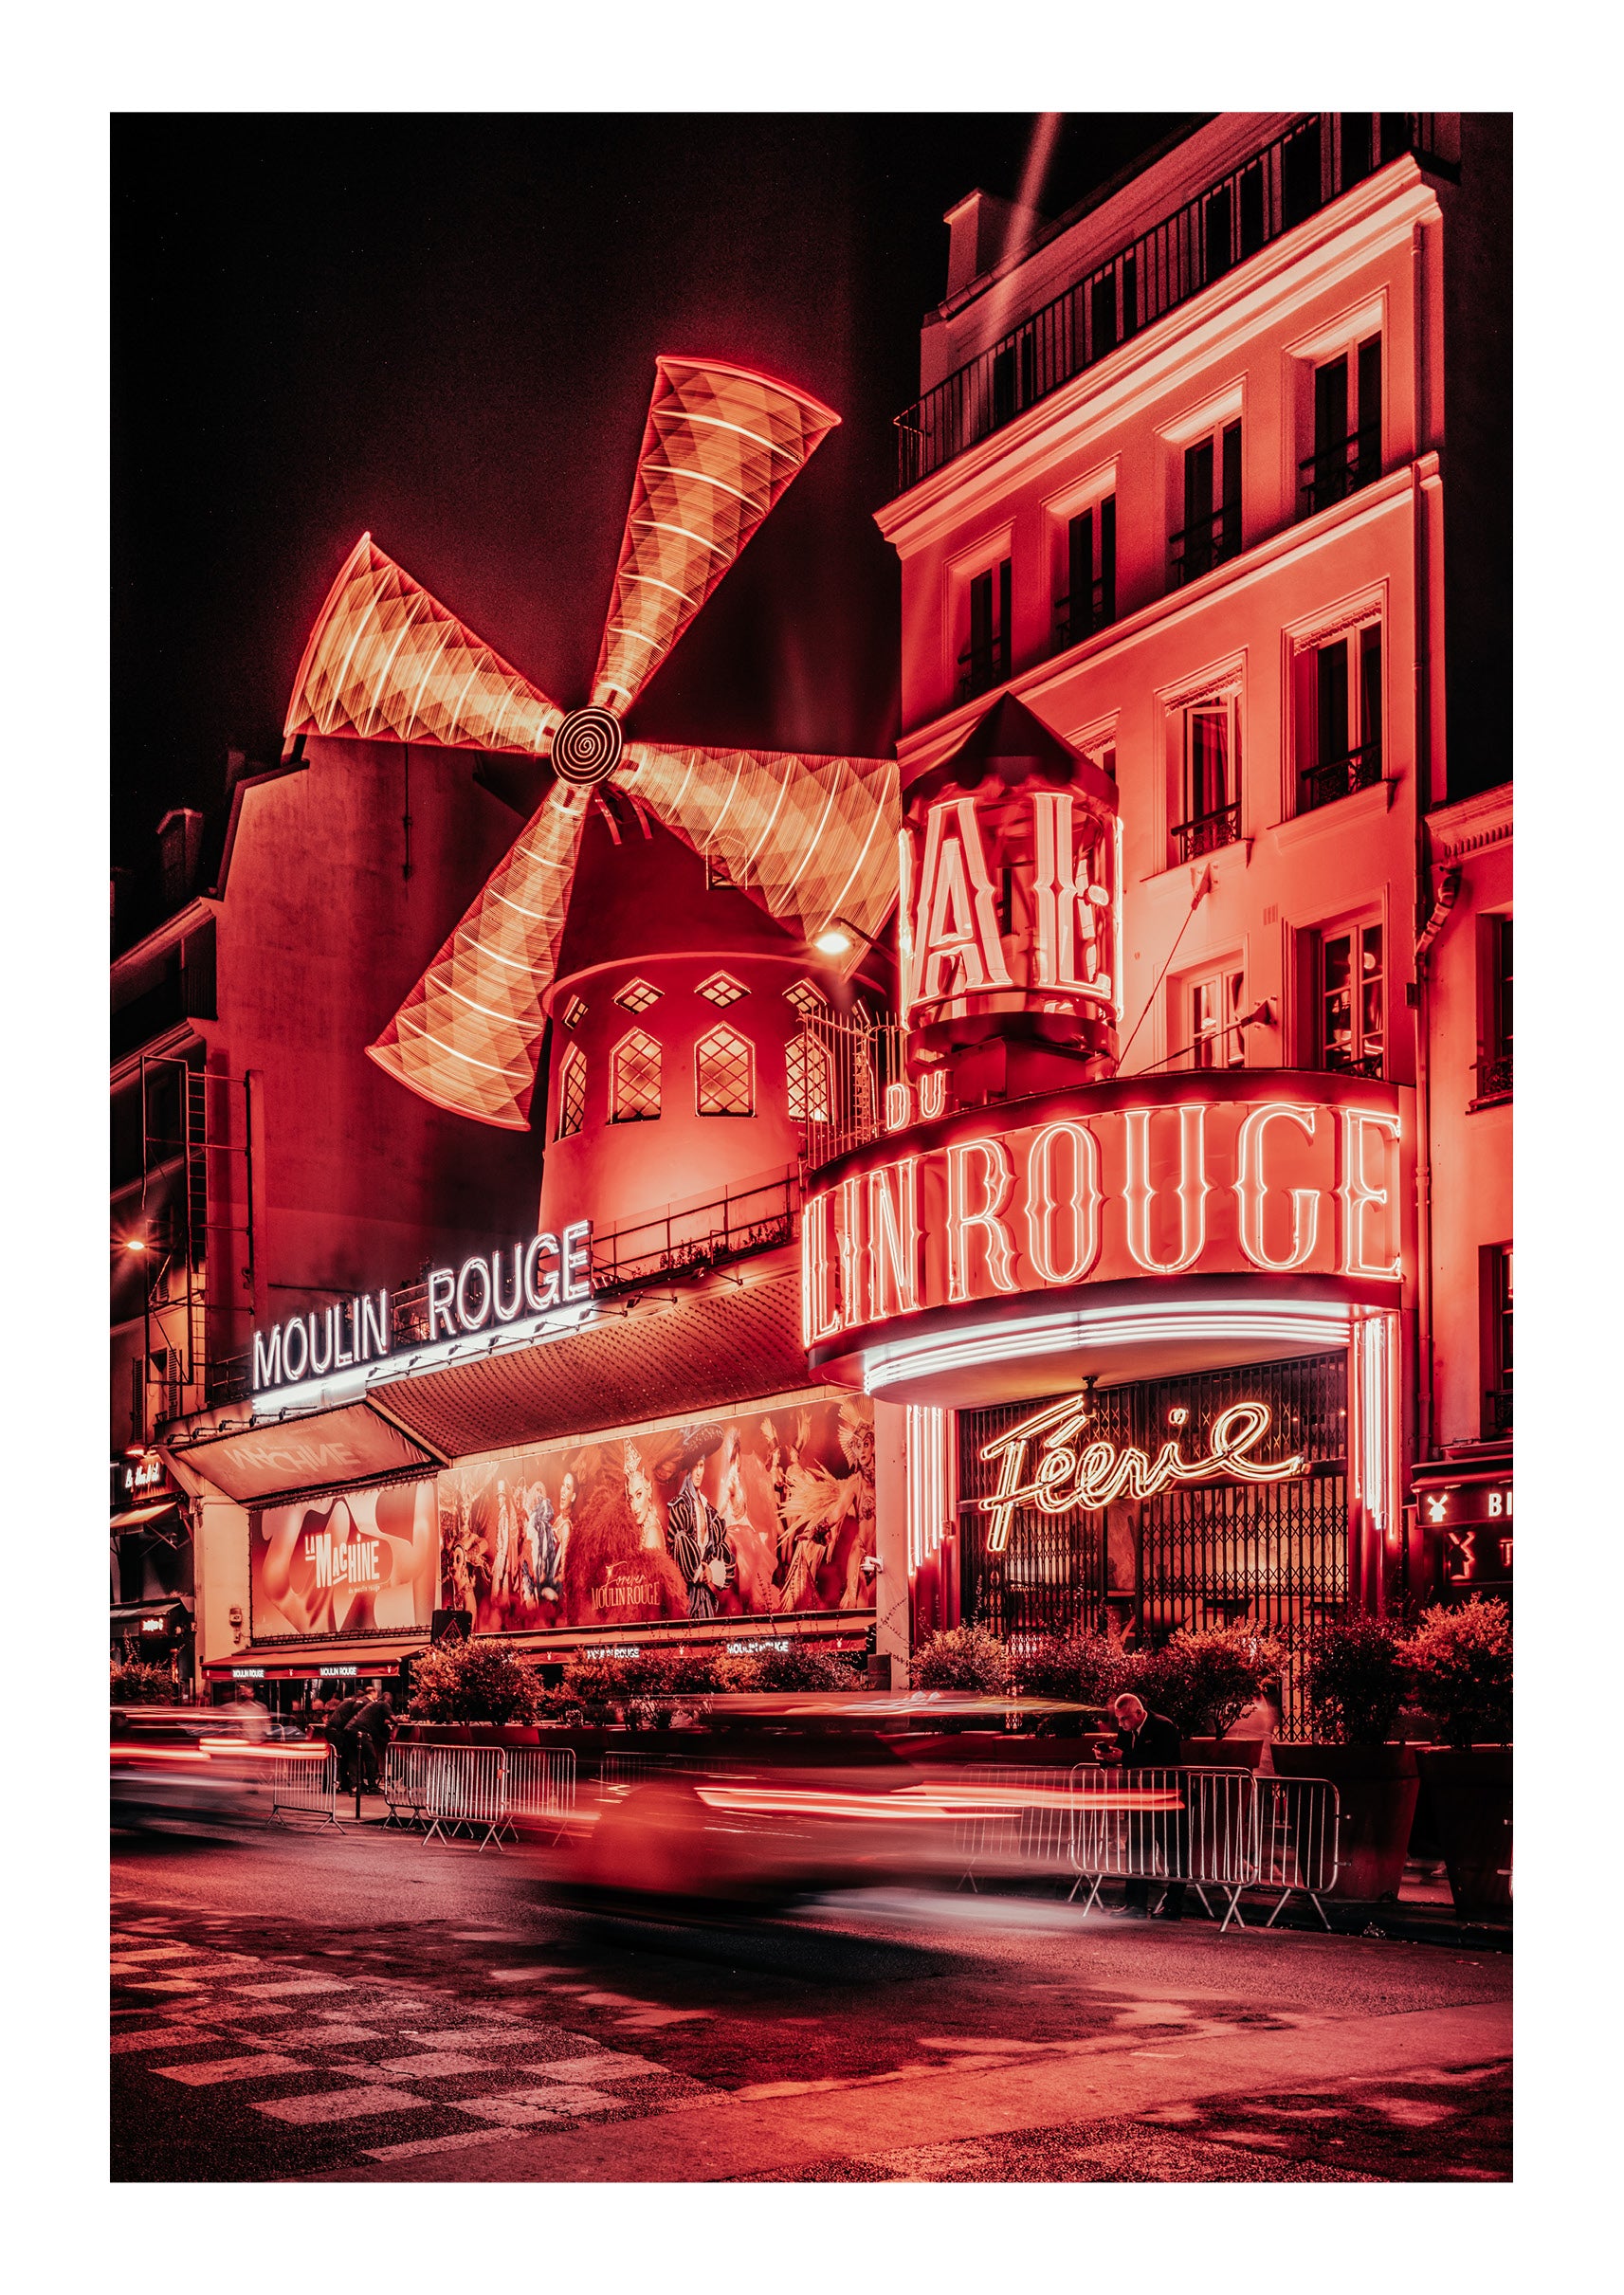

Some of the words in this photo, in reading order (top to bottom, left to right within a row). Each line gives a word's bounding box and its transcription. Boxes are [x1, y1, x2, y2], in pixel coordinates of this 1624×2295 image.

[900, 792, 1112, 1029] AL
[886, 1070, 946, 1130] DU
[803, 1158, 920, 1347] LIN
[946, 1102, 1403, 1303] ROUGE
[252, 1288, 392, 1391] MOULIN
[428, 1219, 593, 1341] ROUGE
[979, 1393, 1306, 1552] Féerie
[304, 1536, 316, 1556] LA
[592, 1587, 626, 1611] MOULIN
[627, 1581, 661, 1606] ROUGE
[600, 1560, 646, 1589] Forever
[232, 1668, 249, 1678] MOULIN
[249, 1668, 265, 1678] ROUGE
[319, 1667, 338, 1676] MOULIN
[339, 1666, 357, 1676] ROUGE
